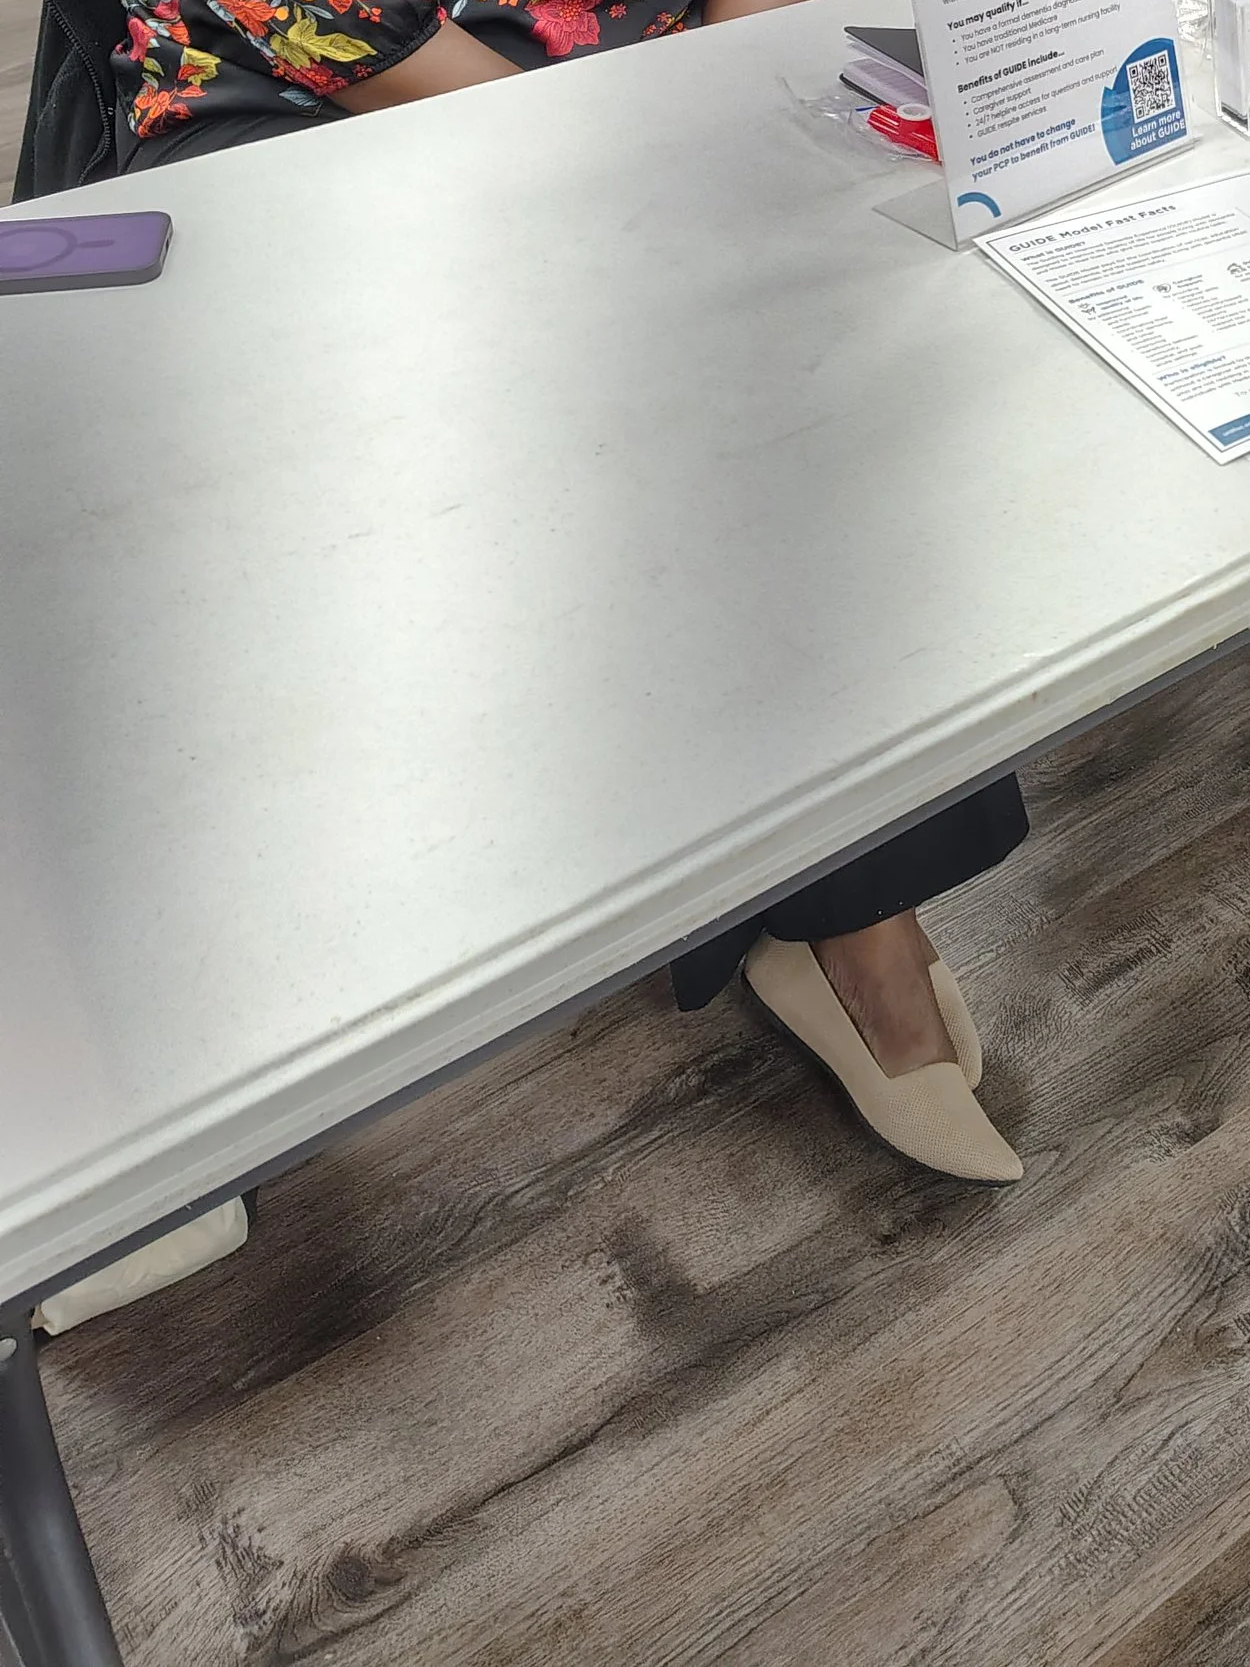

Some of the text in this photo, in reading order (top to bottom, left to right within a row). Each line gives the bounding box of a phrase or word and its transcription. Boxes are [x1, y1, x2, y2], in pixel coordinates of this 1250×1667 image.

[947, 19, 964, 30] You
[966, 13, 984, 24] may
[986, 2, 1015, 20] qualify
[957, 74, 992, 92] Benefits
[1002, 60, 1027, 76] GUIDE
[1028, 52, 1064, 67] include...
[970, 154, 987, 166] You
[1000, 141, 1013, 154] not
[1014, 134, 1035, 148] have
[1046, 118, 1075, 135] change
[1130, 119, 1186, 150] about GUIDE
[1132, 112, 1181, 137] Learn more
[972, 165, 992, 180] your
[993, 156, 1009, 170] PCP
[1020, 141, 1049, 160] benefit
[1050, 136, 1068, 148] from
[1070, 123, 1095, 141] GUIDE!
[1009, 235, 1056, 252] GUIDE
[1059, 222, 1104, 239] Model
[1105, 213, 1137, 227] Fast
[1138, 204, 1176, 219] Facts
